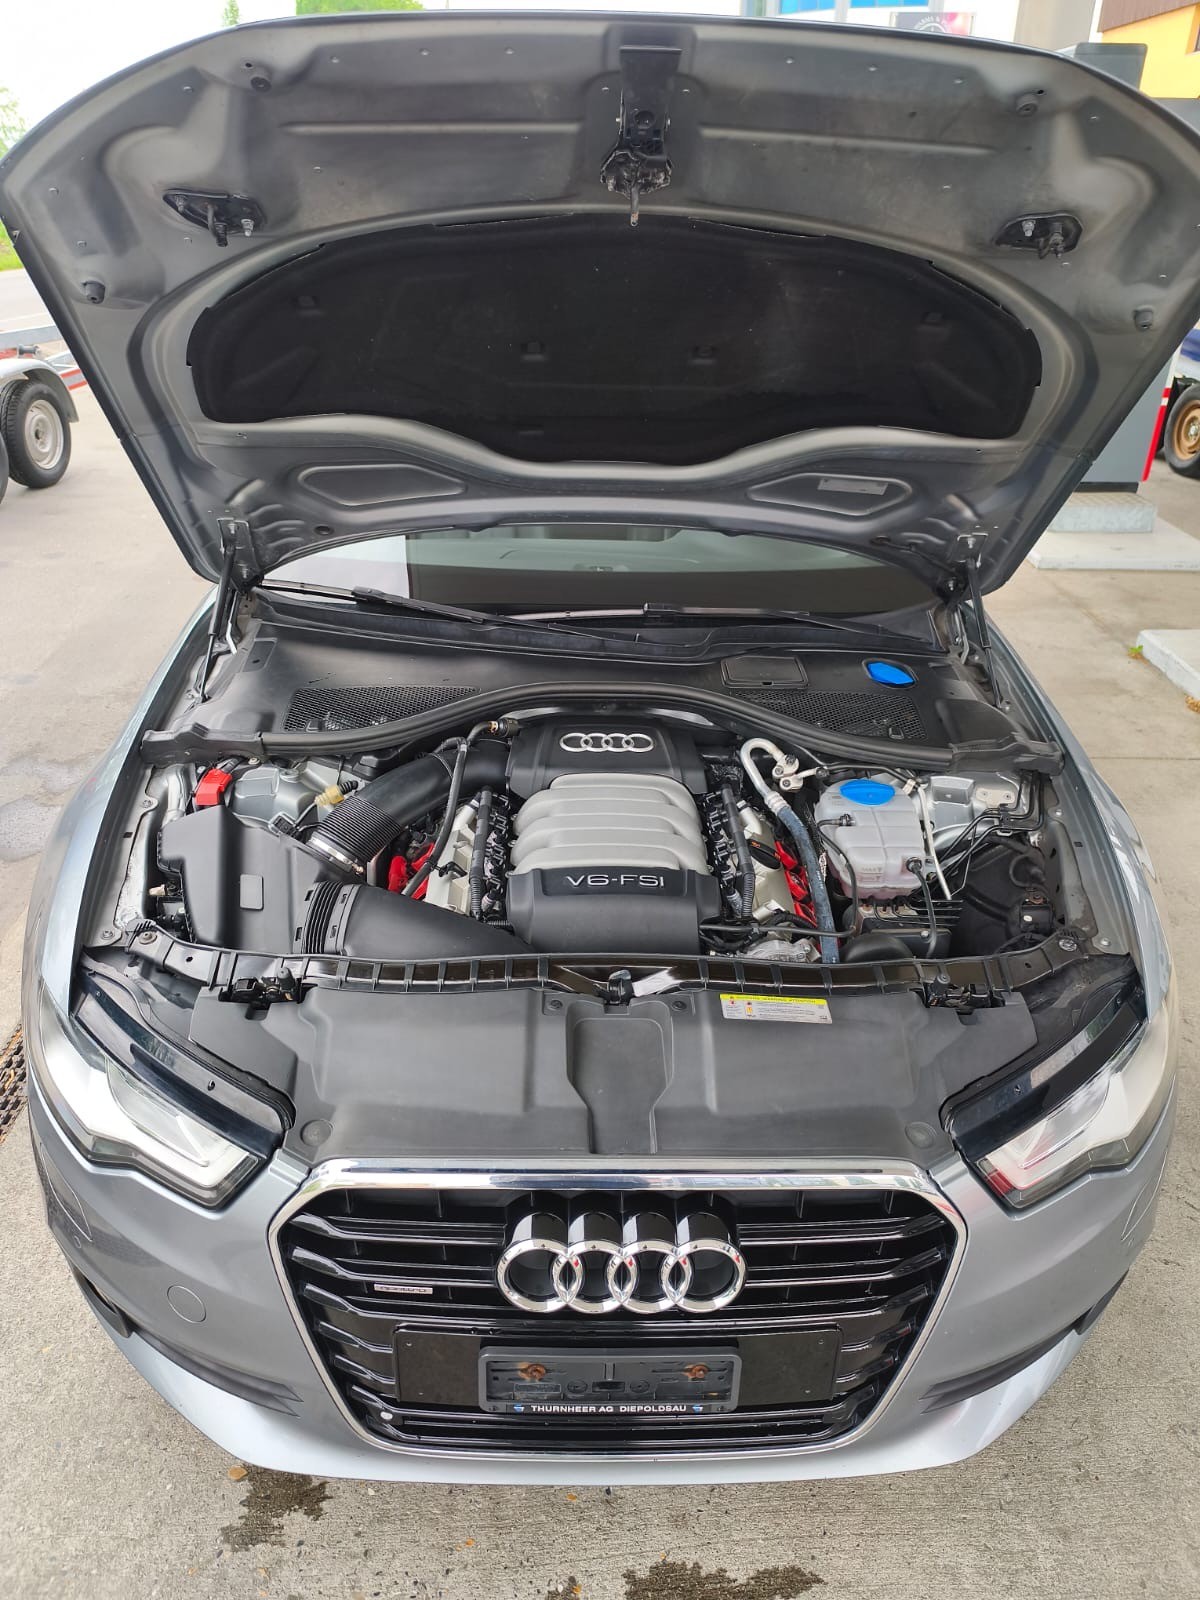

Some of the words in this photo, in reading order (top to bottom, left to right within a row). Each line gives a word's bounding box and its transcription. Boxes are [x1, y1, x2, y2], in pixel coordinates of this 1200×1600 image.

[565, 874, 665, 888] V6-FSI
[530, 1405, 596, 1413] THURNHEER
[598, 1405, 614, 1413] AG
[619, 1405, 687, 1413] DIEPOLDSAU
